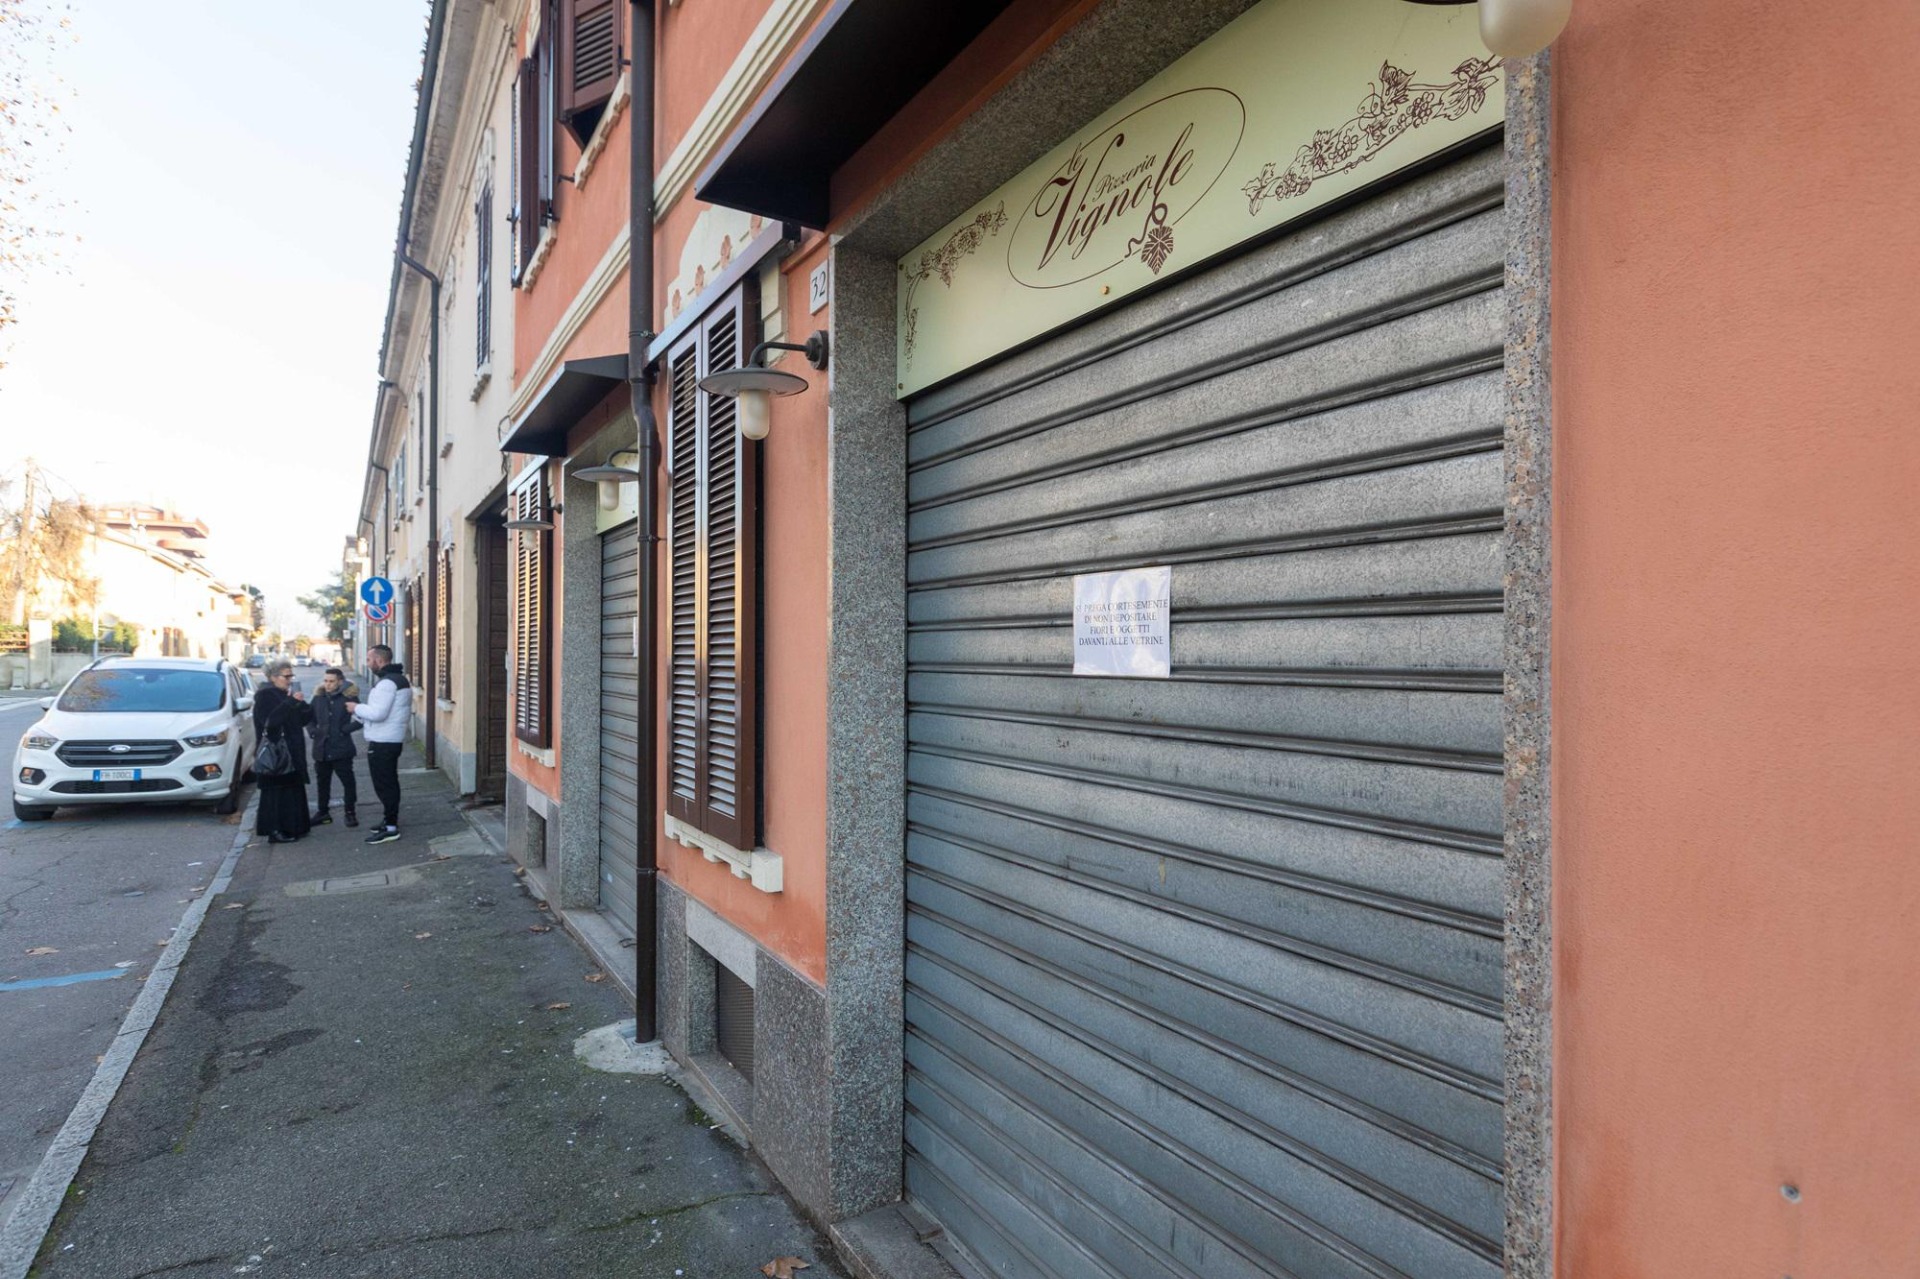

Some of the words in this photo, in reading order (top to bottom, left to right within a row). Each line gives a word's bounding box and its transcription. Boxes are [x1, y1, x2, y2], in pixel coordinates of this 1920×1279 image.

[1092, 154, 1156, 201] Pizzeria
[1035, 122, 1194, 271] Vignole
[812, 270, 827, 303] 32
[1084, 603, 1107, 612] PREGA
[1107, 599, 1168, 611] CORTESEMENTE
[1084, 615, 1092, 624] DI
[1093, 614, 1108, 623] NON
[1110, 612, 1157, 623] DEPOSITARE
[1090, 626, 1108, 635] FIORI
[1110, 625, 1115, 634] E
[1116, 624, 1150, 634] OGGETTI
[1079, 637, 1108, 646] DAVANTI
[1108, 636, 1128, 646] ALLE
[1130, 635, 1164, 646] VETRINE
